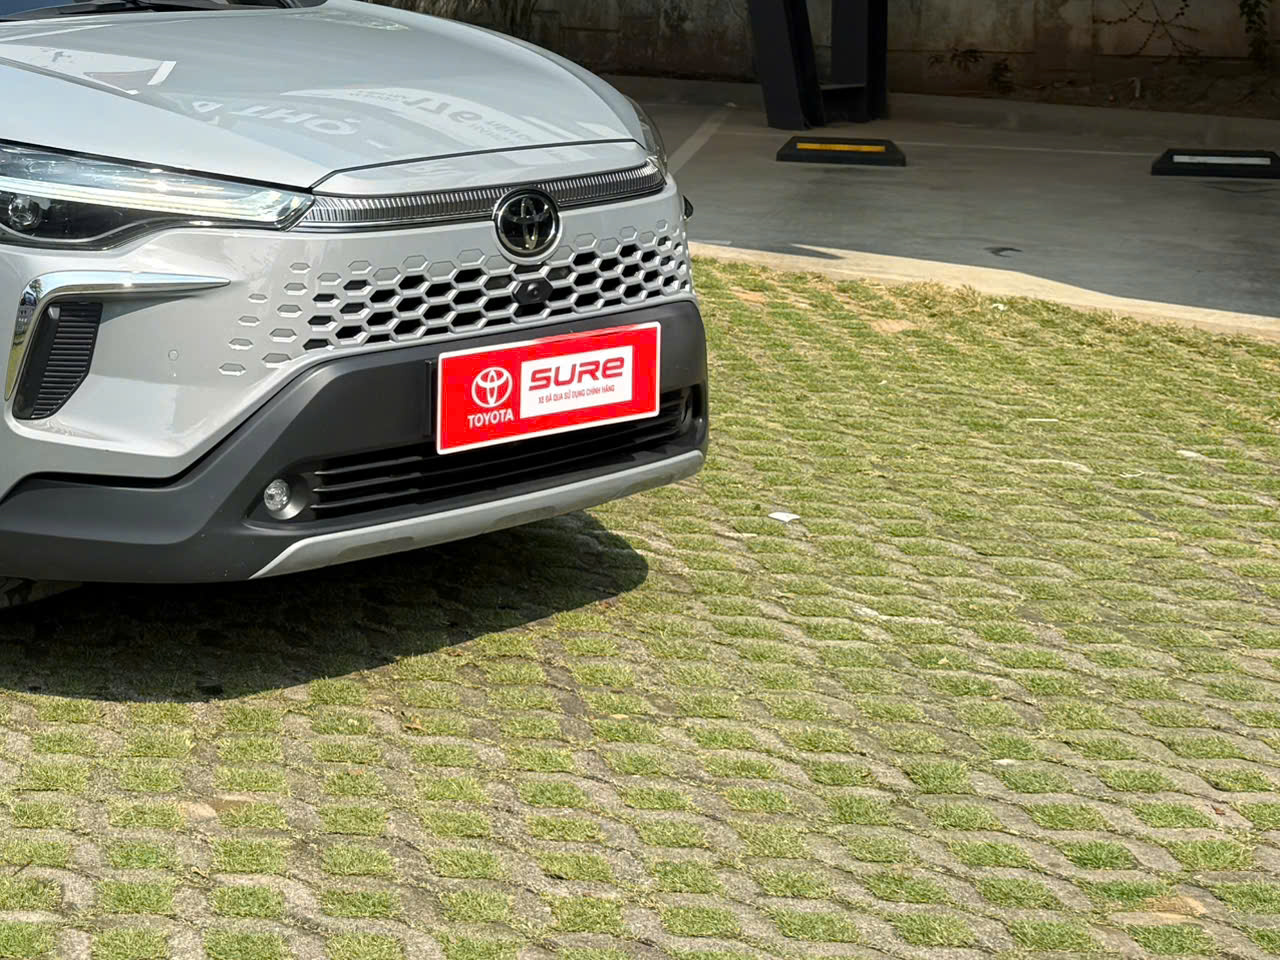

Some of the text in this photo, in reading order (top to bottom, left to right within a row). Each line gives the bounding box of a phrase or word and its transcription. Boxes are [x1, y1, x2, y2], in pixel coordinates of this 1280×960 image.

[553, 392, 563, 401] QUA
[586, 385, 601, 396] CHÍNH
[467, 408, 515, 429] TOYOTA
